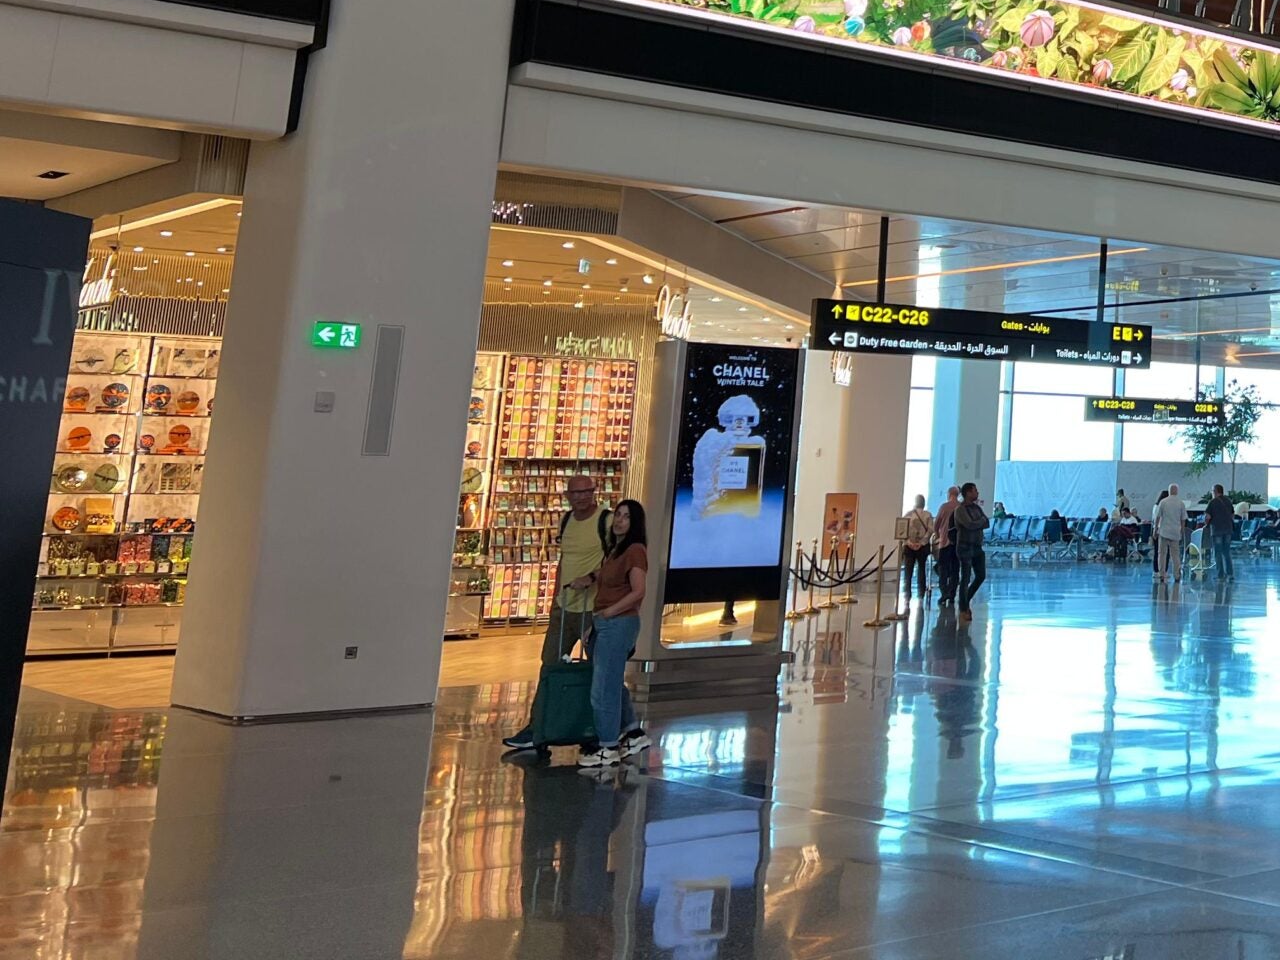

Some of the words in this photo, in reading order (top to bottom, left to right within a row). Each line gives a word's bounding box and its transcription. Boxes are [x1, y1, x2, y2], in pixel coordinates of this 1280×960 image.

[861, 306, 929, 326] C22-C26
[1001, 320, 1023, 330] Gates
[1028, 323, 1050, 334] بوابات
[1112, 326, 1121, 340] E
[859, 336, 878, 349] Duty
[880, 337, 898, 348] Free
[899, 339, 928, 349] Garden
[934, 341, 961, 351] الحديقة
[967, 342, 984, 354] الحرة
[984, 345, 1009, 356] السوق
[1055, 348, 1078, 359] Toilets
[1101, 352, 1120, 362] دورات
[712, 363, 770, 379] CHANEL
[717, 378, 746, 387] WINTER
[747, 379, 764, 387] TALE
